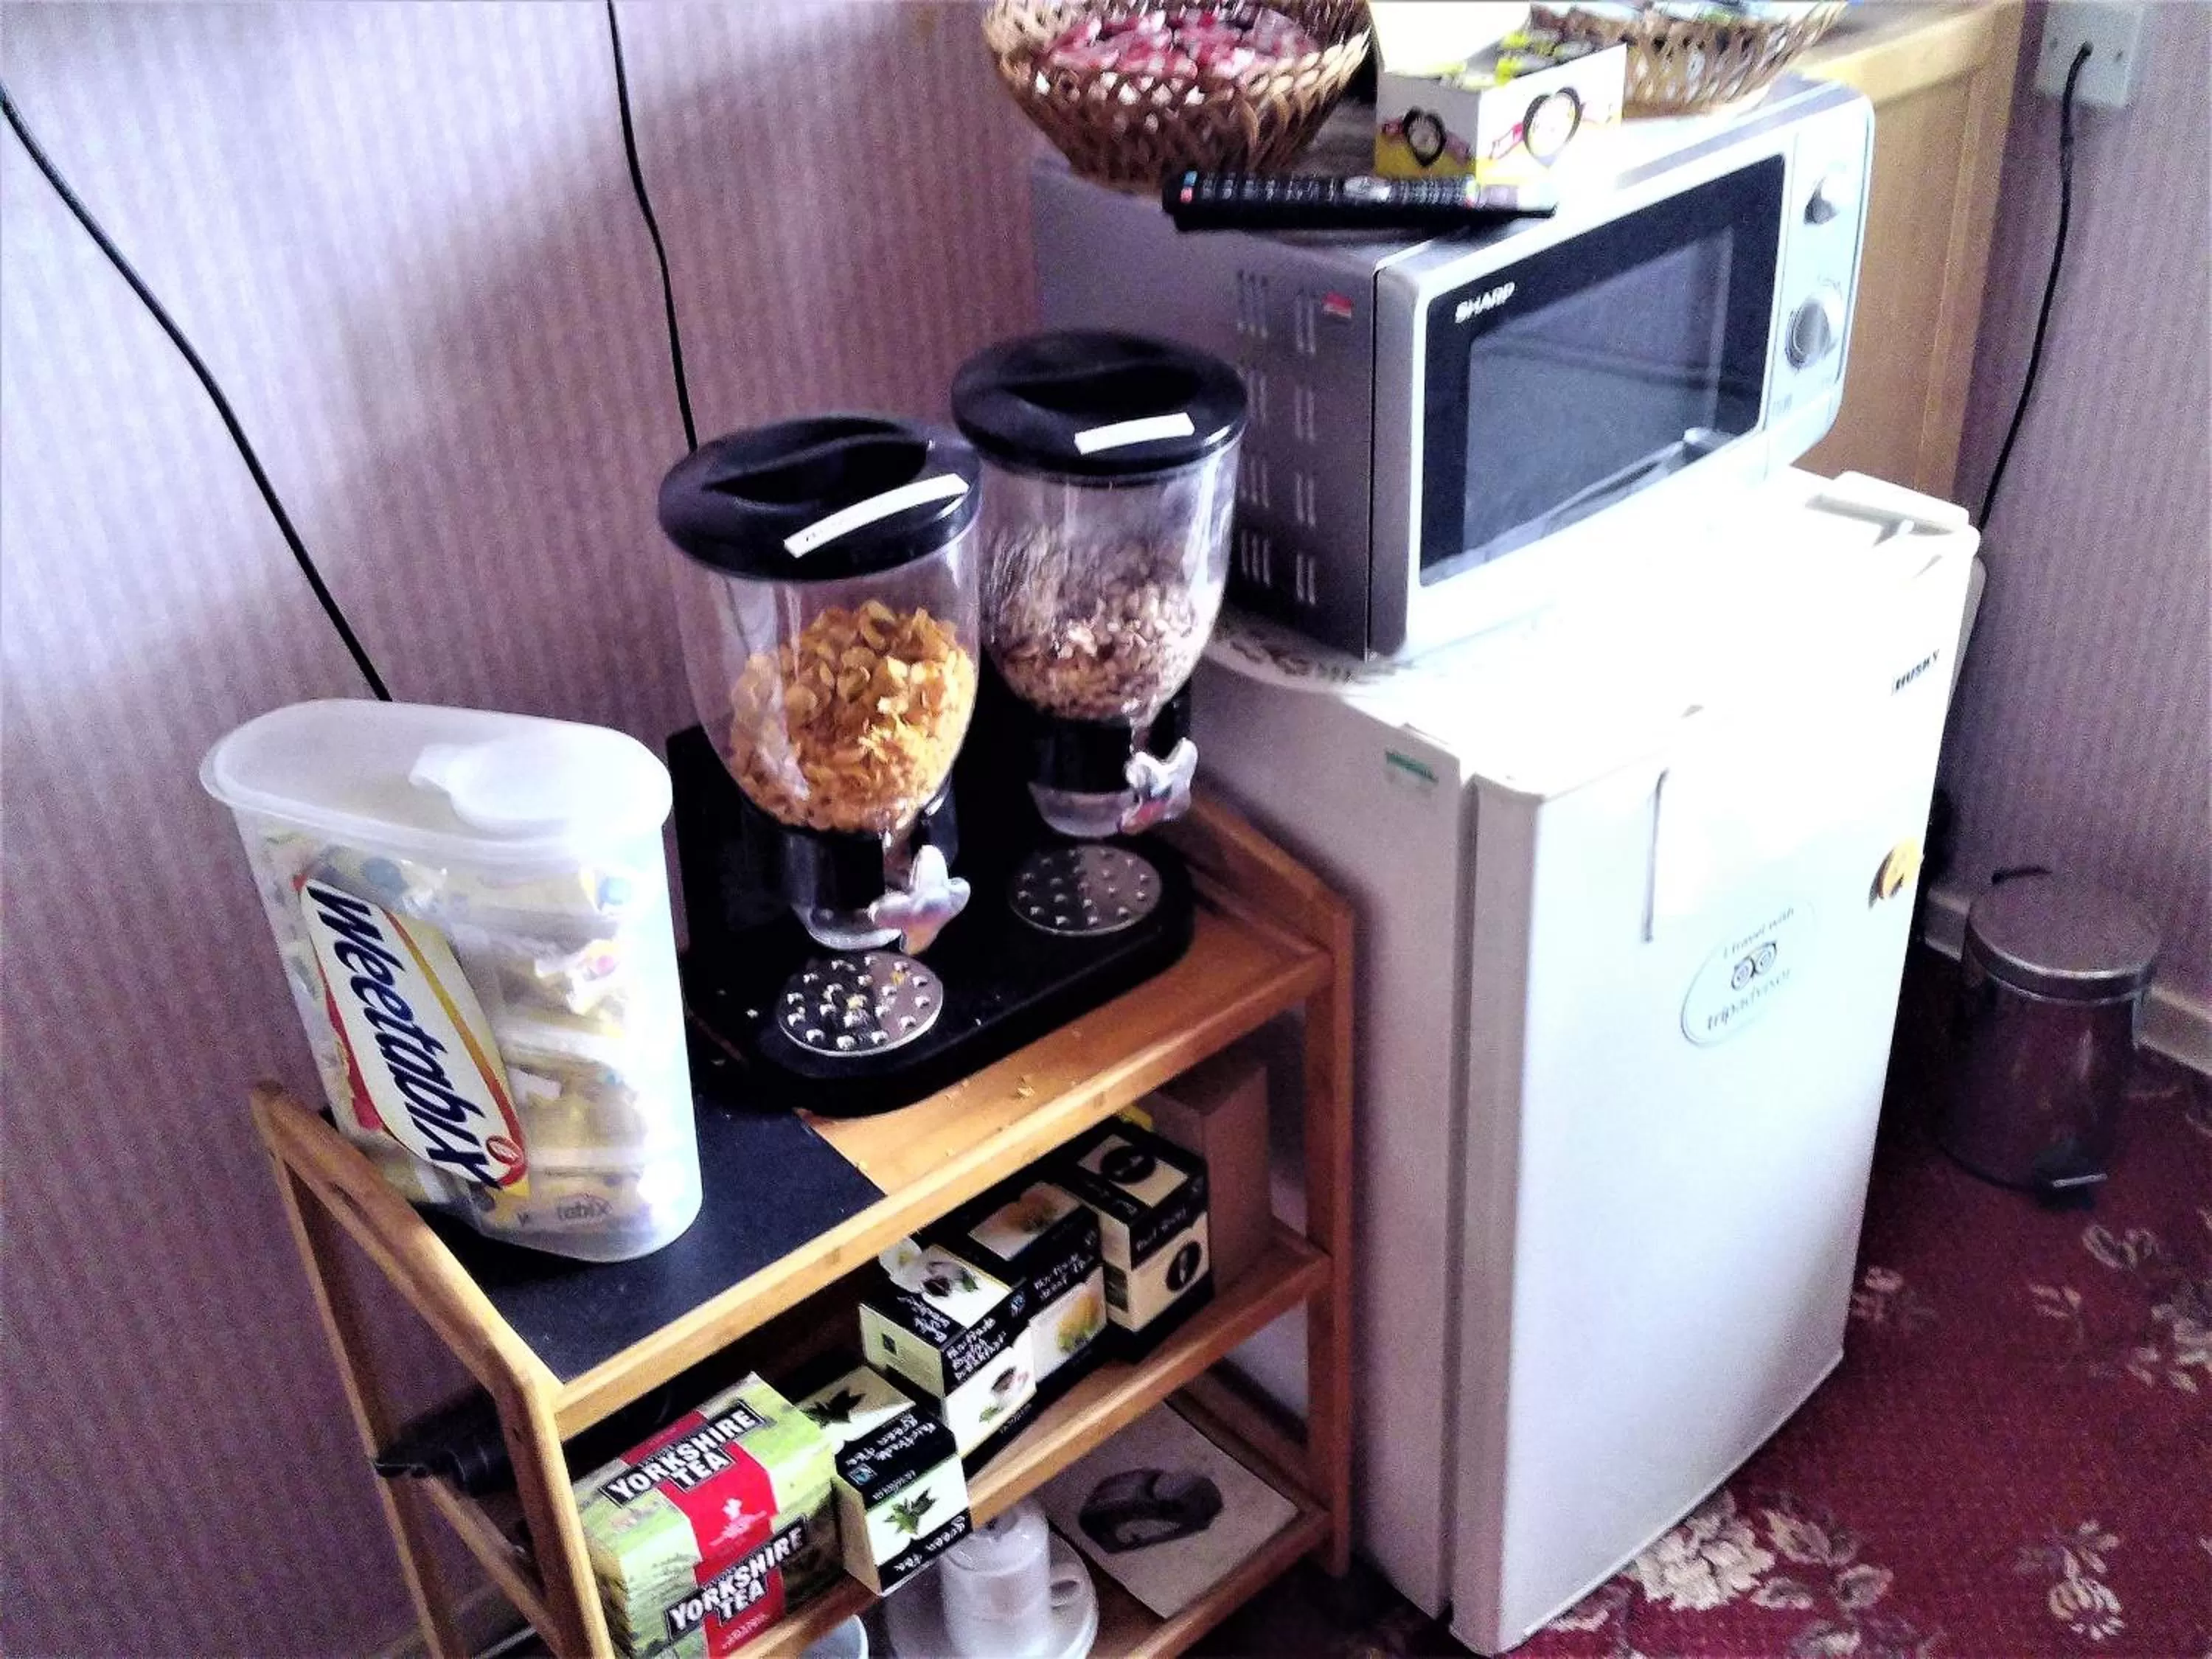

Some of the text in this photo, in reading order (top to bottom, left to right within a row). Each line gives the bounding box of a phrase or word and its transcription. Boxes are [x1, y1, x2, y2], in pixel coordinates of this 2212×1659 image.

[1455, 282, 1515, 323] SHARP
[307, 886, 504, 1190] Weetabix
[606, 1408, 756, 1502] YORKSHIRE
[670, 1449, 732, 1490] TEA
[893, 1515, 966, 1571] Green Tea
[667, 1527, 804, 1632] YORKSHIRE
[720, 1582, 766, 1622] TEA
